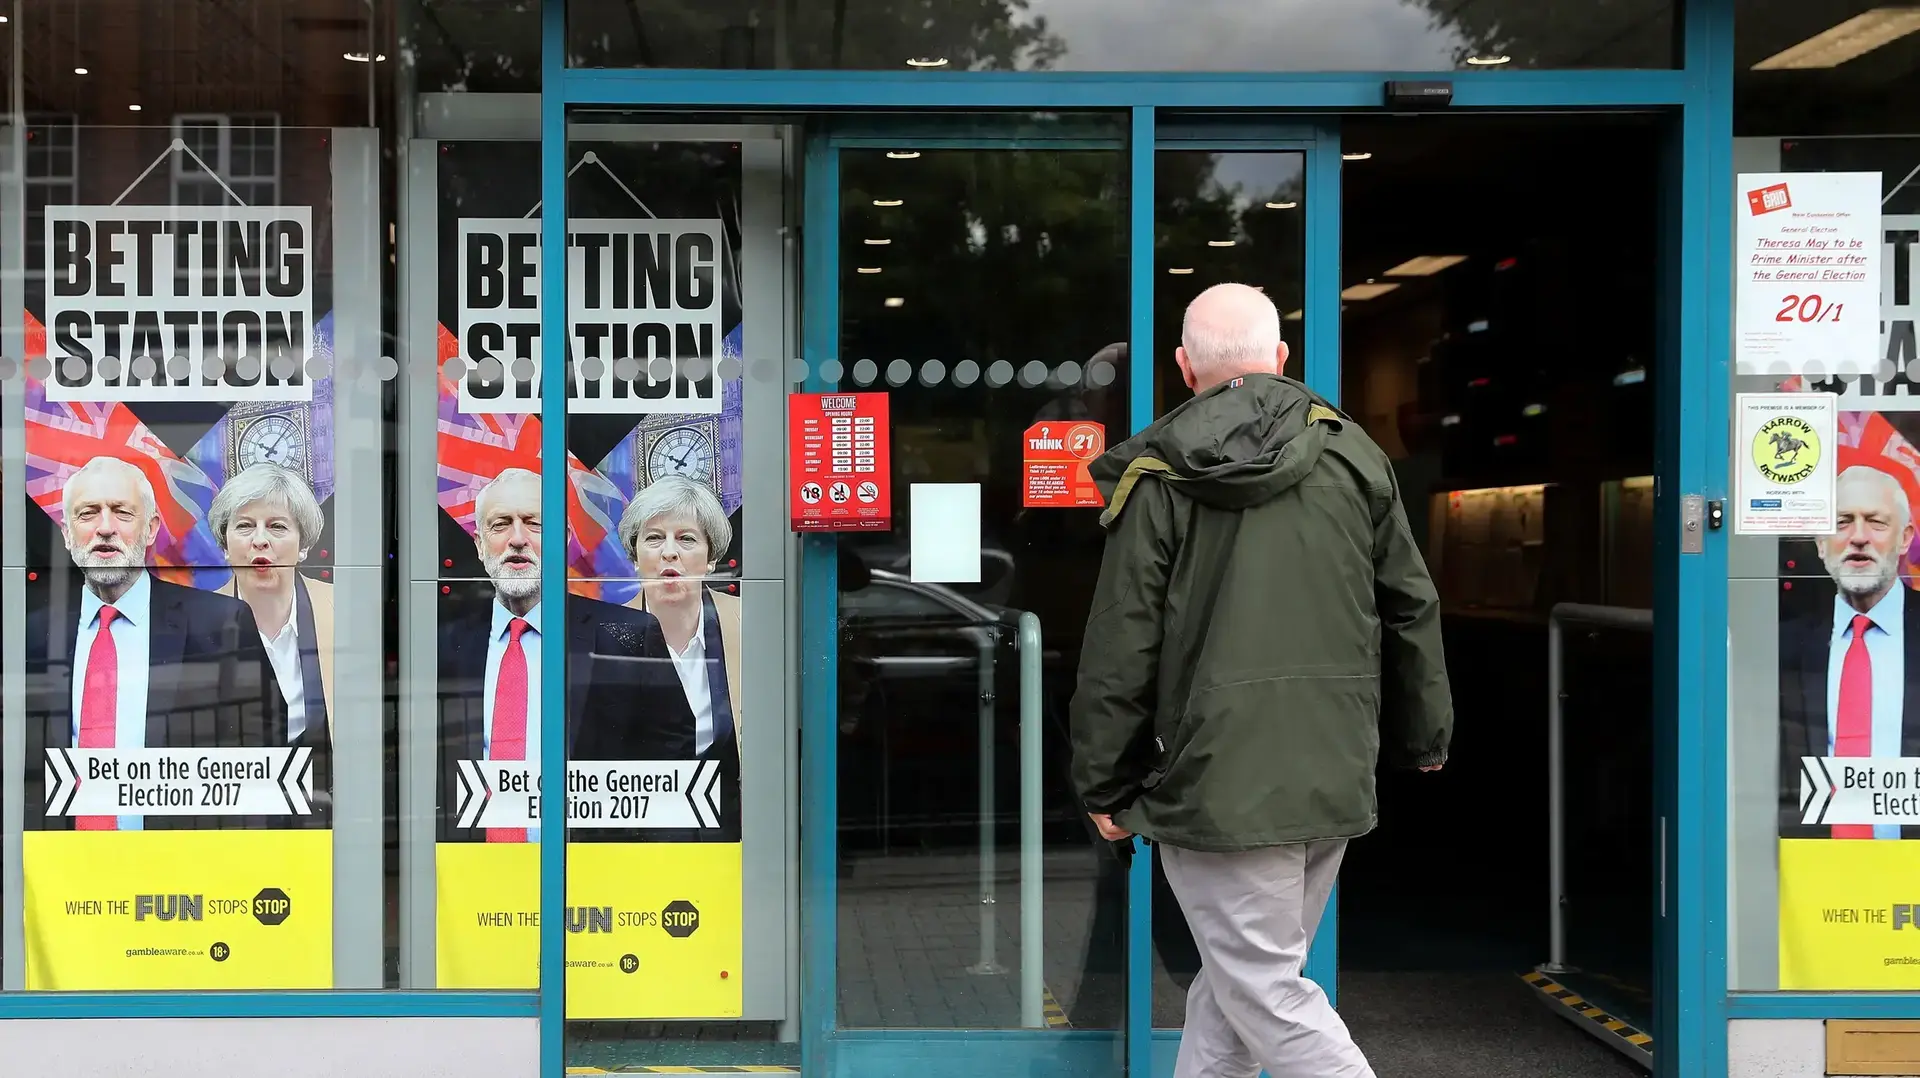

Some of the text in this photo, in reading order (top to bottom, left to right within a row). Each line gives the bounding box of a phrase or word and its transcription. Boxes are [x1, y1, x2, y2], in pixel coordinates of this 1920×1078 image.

[1763, 190, 1787, 208] GRID
[1757, 238, 1800, 248] Theresa
[1806, 239, 1828, 250] May
[1850, 238, 1862, 248] be
[54, 220, 304, 298] BETTING
[1750, 254, 1867, 264] Prime Minister after
[466, 233, 714, 310] BETING
[1754, 270, 1866, 280] the General Election
[1776, 294, 1844, 322] 20/1
[54, 310, 304, 388] STATION
[821, 398, 856, 409] WELCOME
[1762, 418, 1811, 434] HARROW
[1029, 434, 1094, 450] THINK 21
[1760, 464, 1813, 482] BETWATCH
[88, 756, 270, 780] Bet on the General
[1844, 766, 1875, 788] Bet
[1883, 772, 1906, 788] on
[500, 770, 529, 792] Bet
[568, 770, 598, 792] the
[606, 770, 678, 792] General
[118, 783, 241, 806] Election 2017
[1873, 793, 1920, 816] Elect
[528, 796, 649, 819] Eltion 2017
[65, 894, 288, 922] WHEN THE FUN STOPS STOP
[1822, 908, 1859, 923] WHEN
[1864, 909, 1887, 923] THE
[477, 906, 697, 934] WHEN THE UN STOPS STOP
[126, 946, 228, 958] gambleaware.co.uk 18+
[622, 958, 637, 970] 18+
